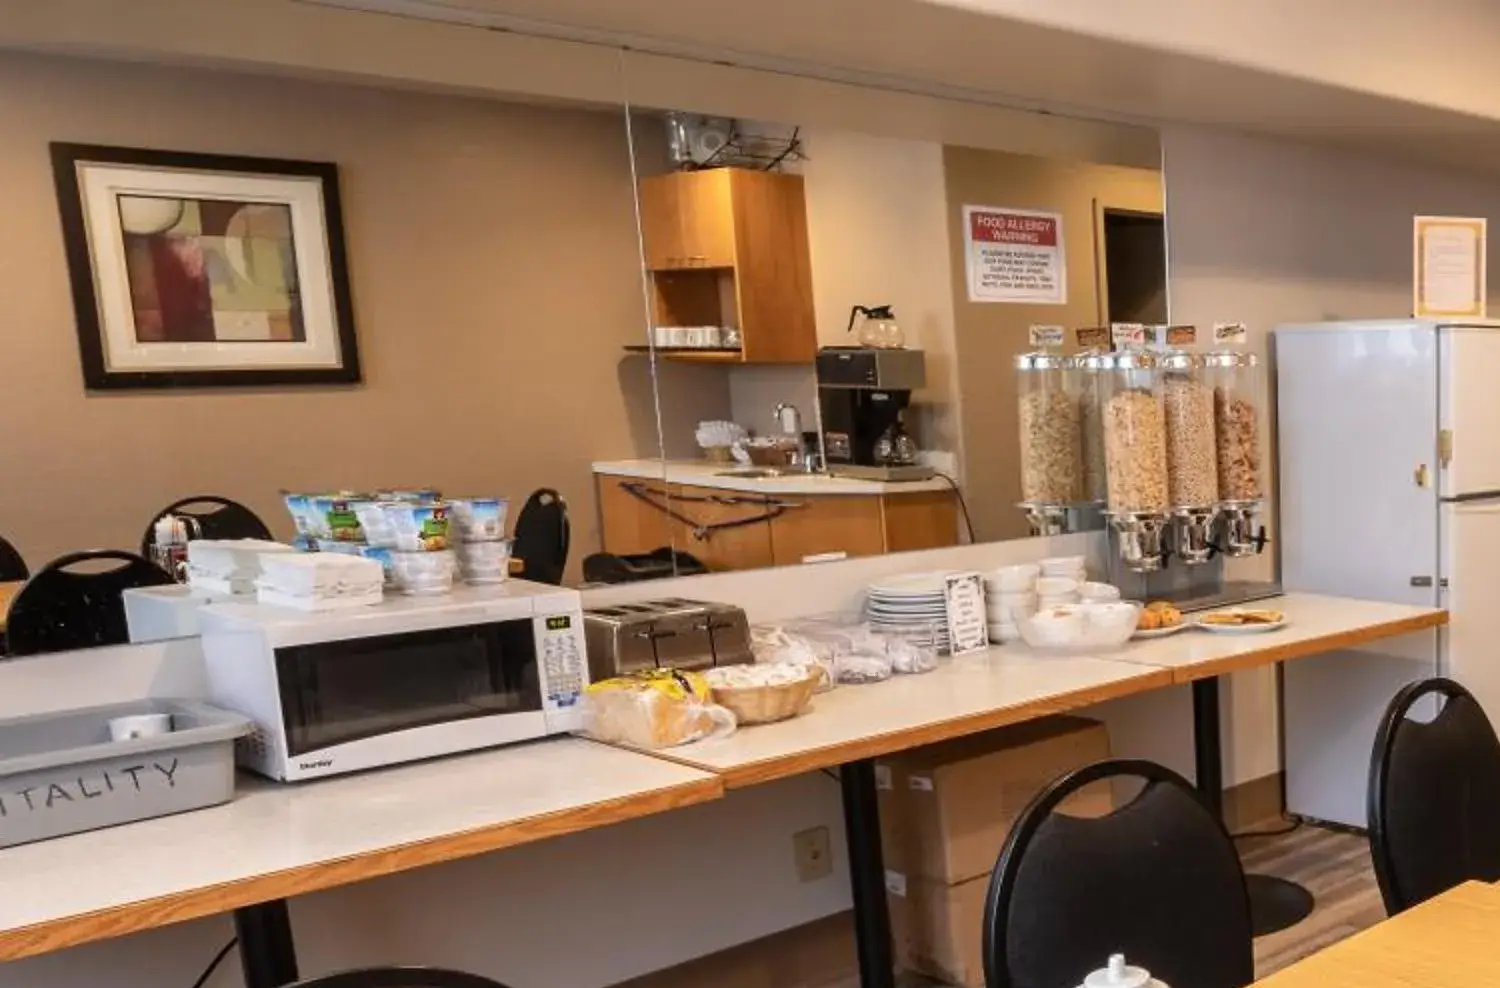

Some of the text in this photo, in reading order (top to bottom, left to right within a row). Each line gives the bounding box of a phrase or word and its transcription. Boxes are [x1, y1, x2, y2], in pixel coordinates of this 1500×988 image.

[977, 215, 1051, 233] FOOD ALLERGY
[992, 229, 1039, 243] WARNING
